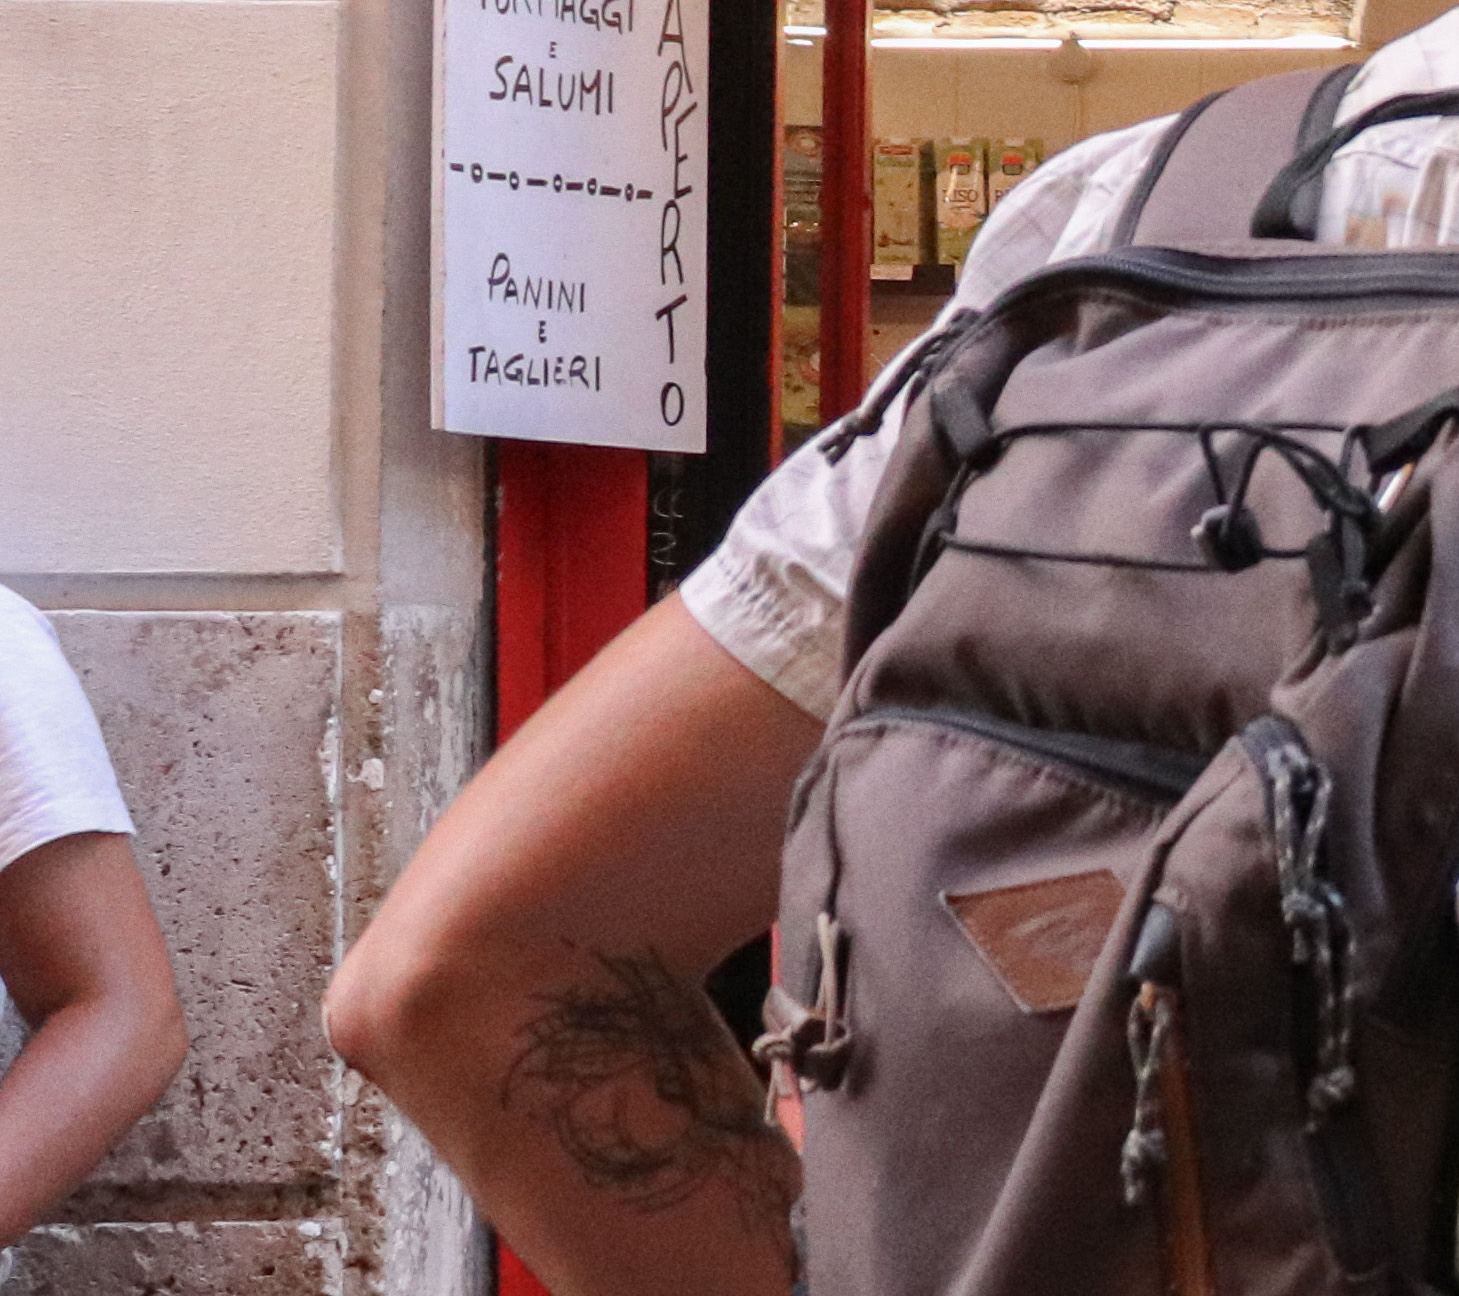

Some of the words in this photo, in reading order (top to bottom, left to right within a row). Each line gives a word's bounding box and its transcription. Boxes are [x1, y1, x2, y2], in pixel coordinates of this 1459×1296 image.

[489, 55, 614, 116] SALUMI
[488, 252, 586, 313] PANINI
[538, 320, 547, 343] E
[469, 346, 600, 392] TAGLIERI
